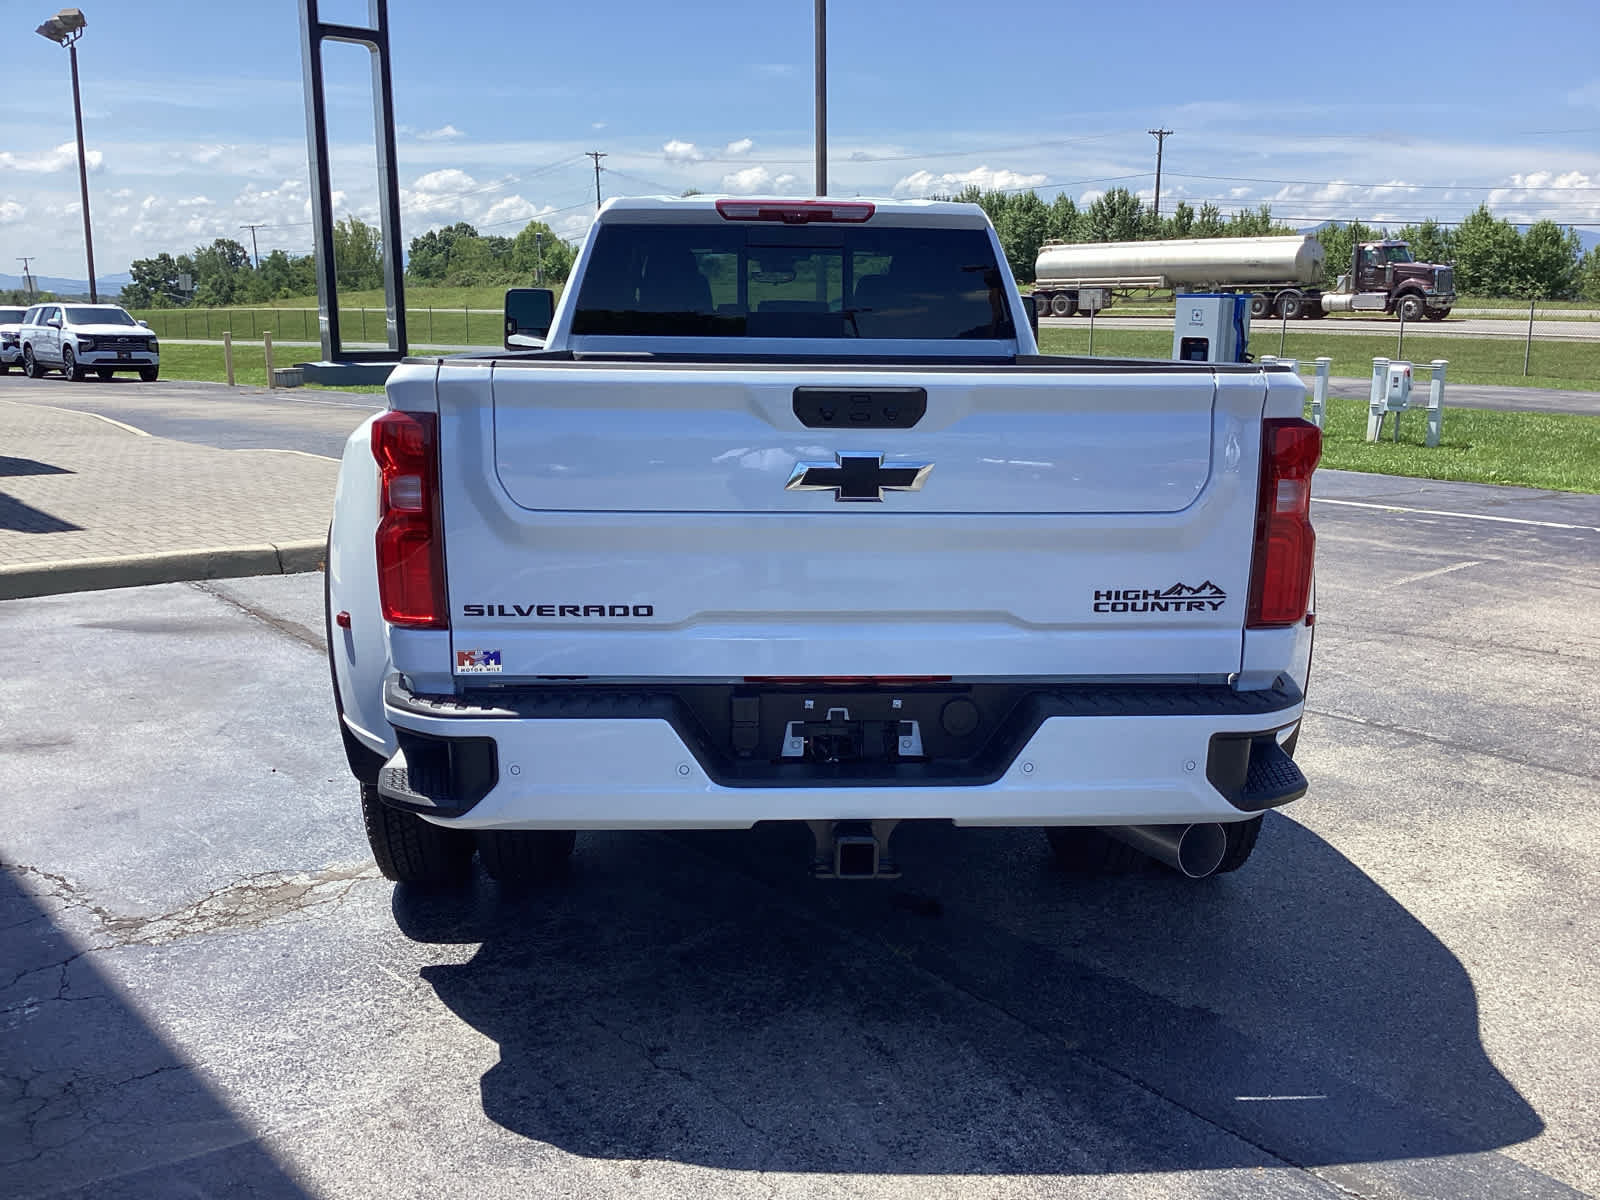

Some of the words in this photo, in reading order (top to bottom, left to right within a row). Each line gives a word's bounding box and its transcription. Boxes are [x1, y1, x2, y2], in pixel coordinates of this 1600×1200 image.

[1094, 590, 1160, 601] HIGH
[463, 604, 654, 617] SILVERADO
[1093, 601, 1225, 613] COUNTRY
